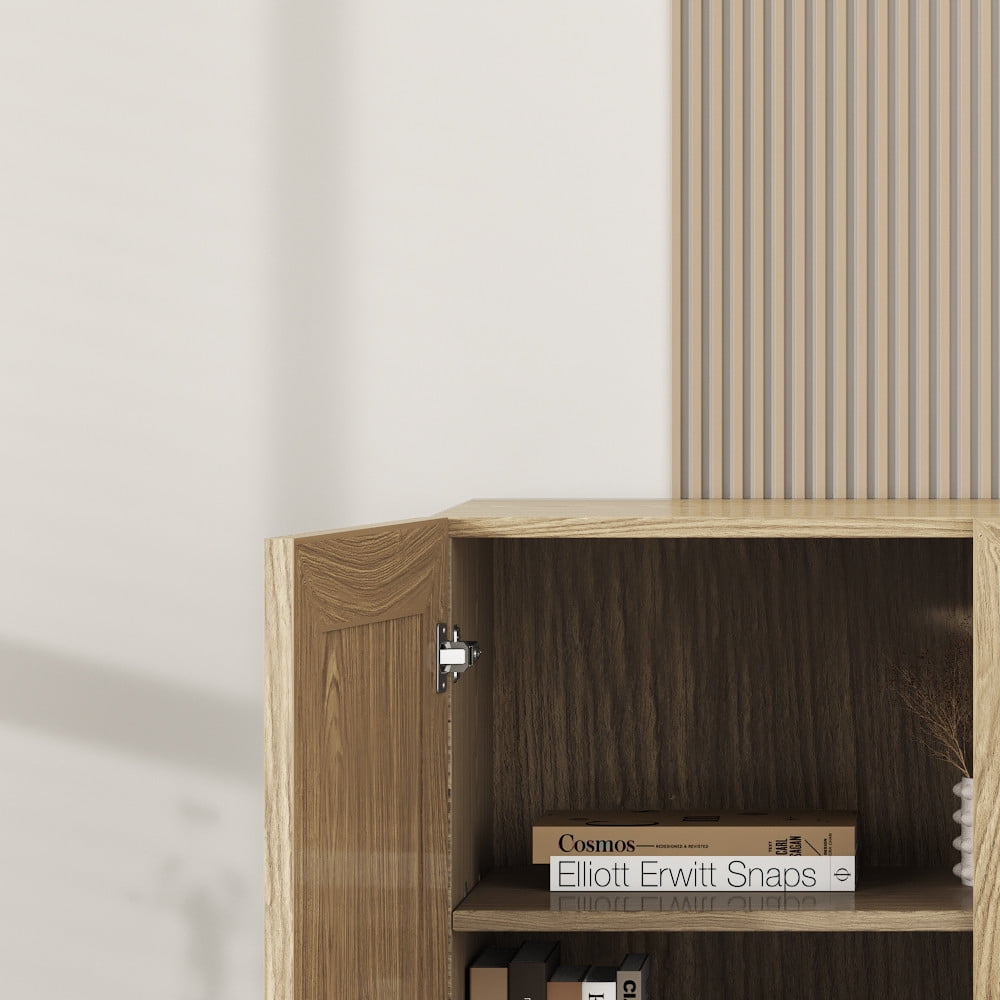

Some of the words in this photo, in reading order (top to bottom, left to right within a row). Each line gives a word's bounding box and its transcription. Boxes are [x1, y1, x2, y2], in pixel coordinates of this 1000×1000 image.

[559, 834, 635, 852] Cosmos
[776, 838, 787, 855] CARL
[559, 861, 629, 887] Elliott
[641, 861, 716, 887] Erwitt
[727, 860, 817, 891] Snaps
